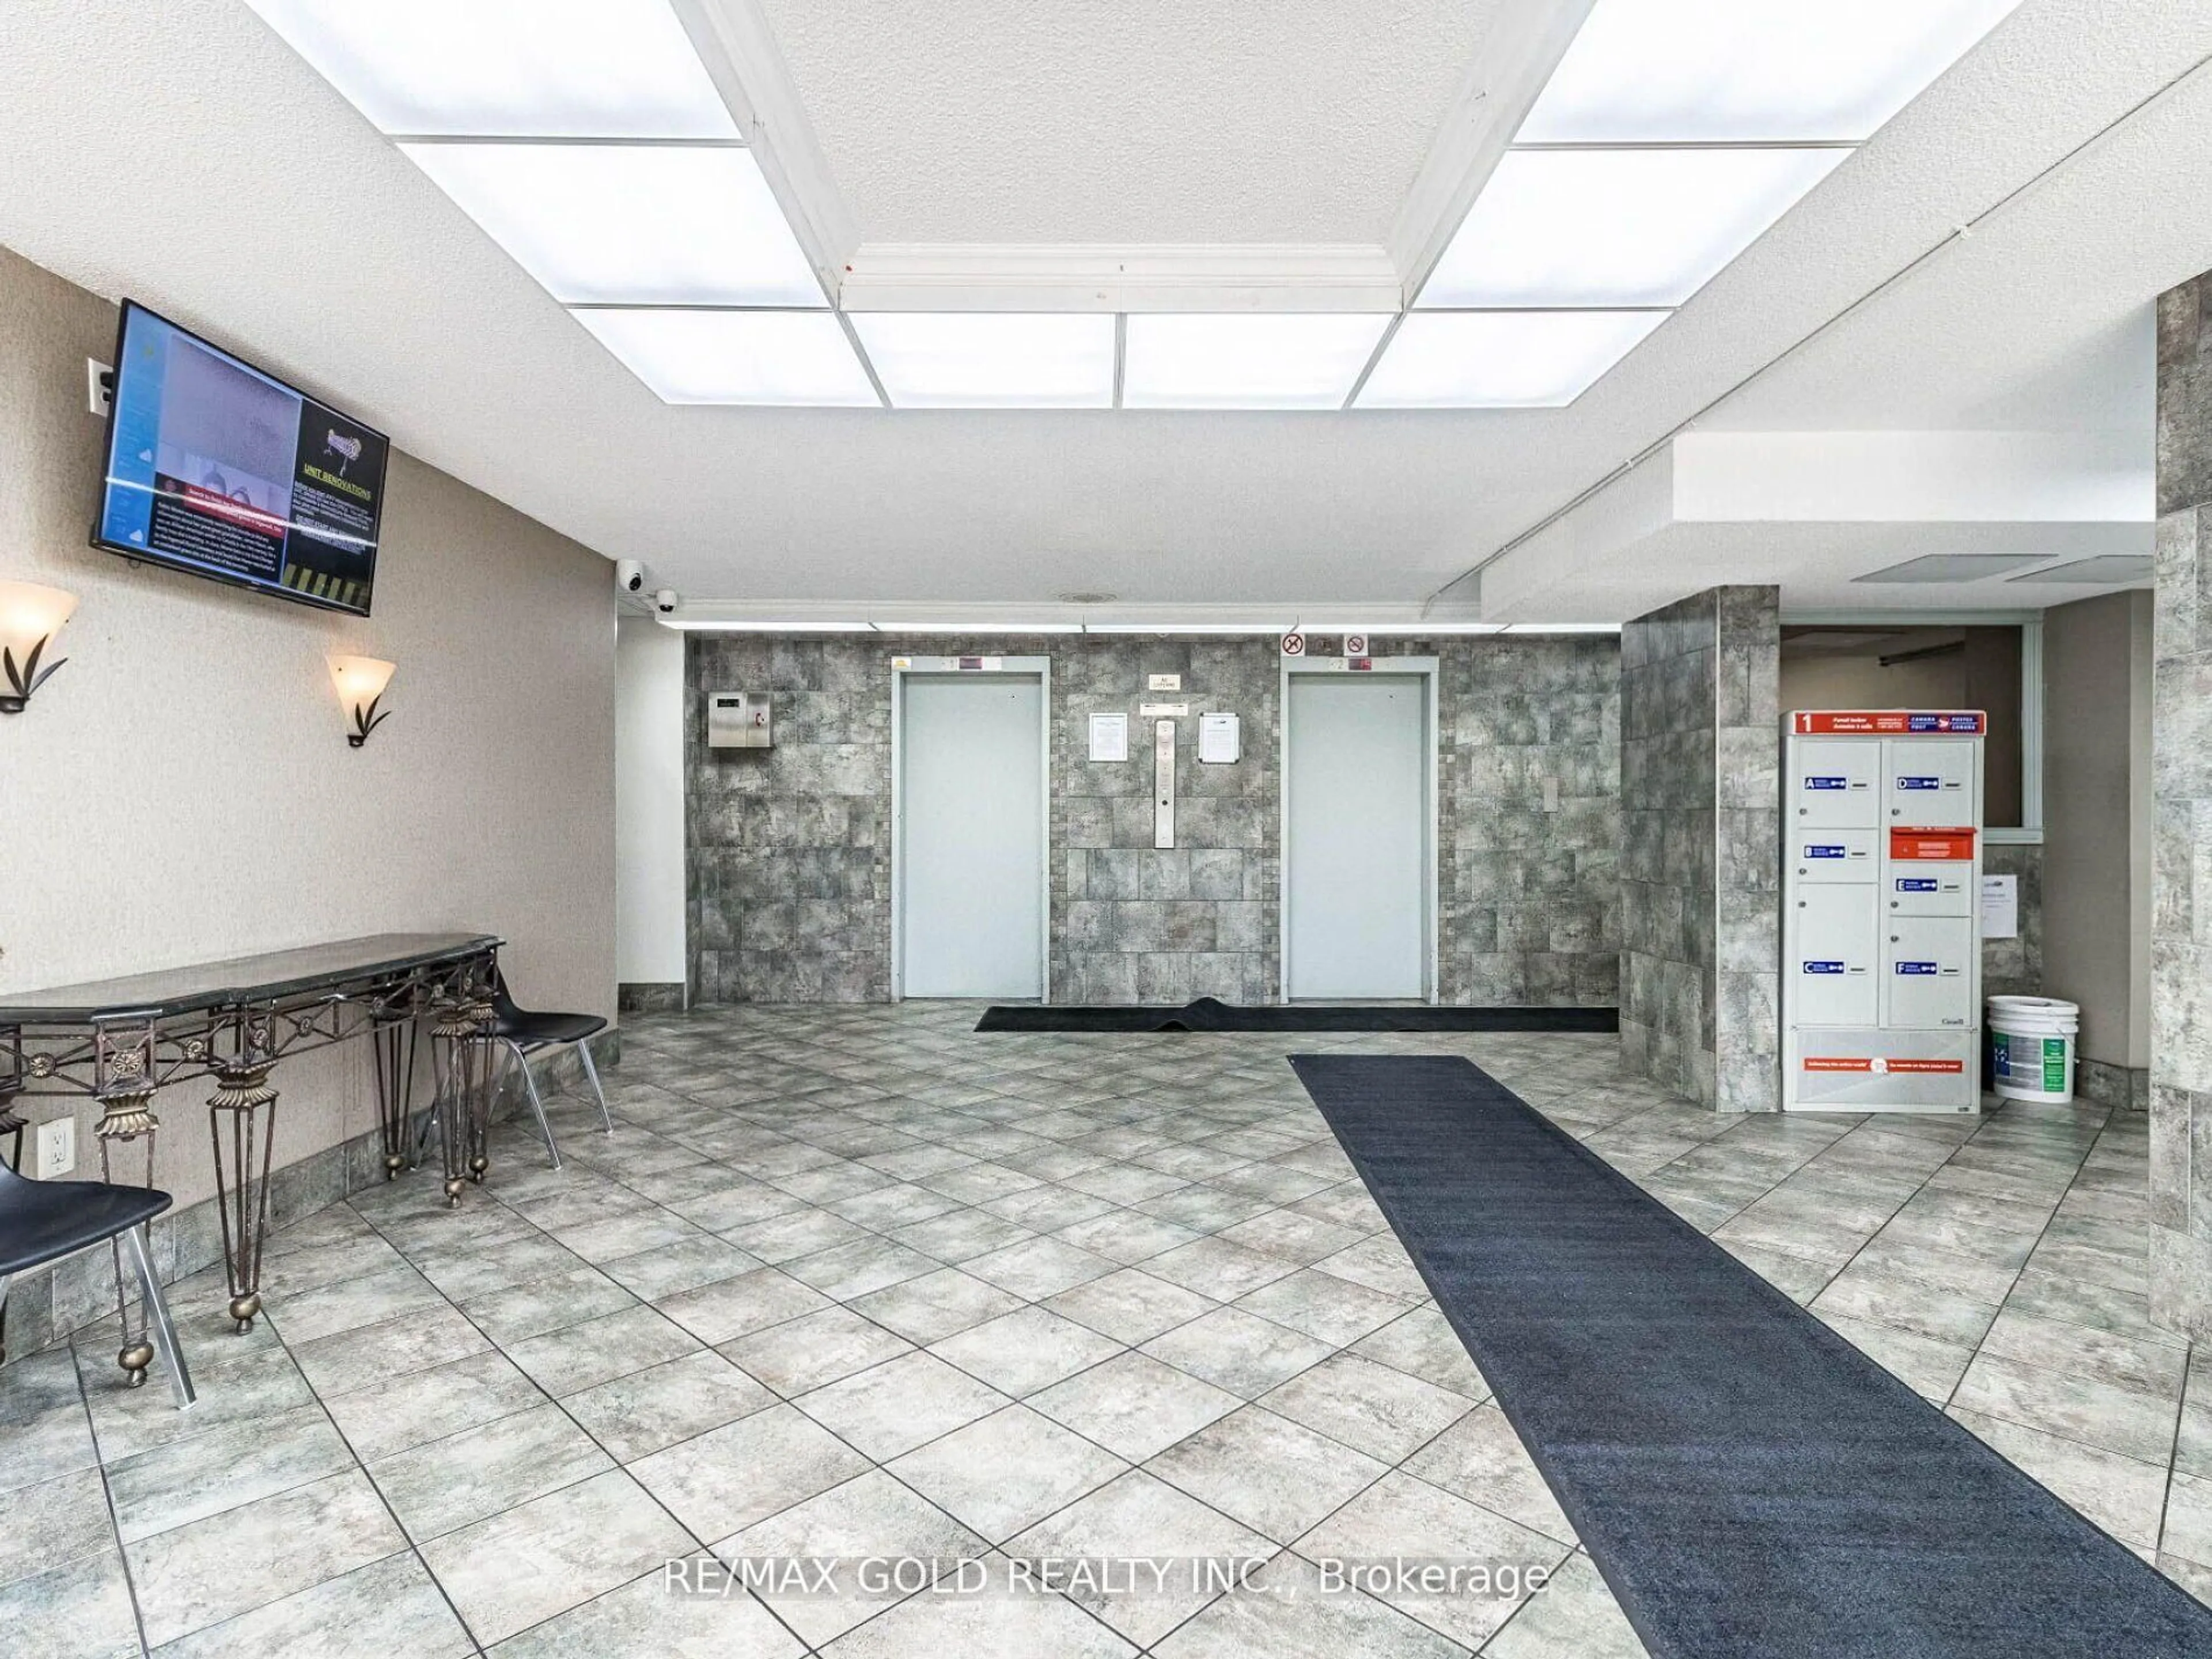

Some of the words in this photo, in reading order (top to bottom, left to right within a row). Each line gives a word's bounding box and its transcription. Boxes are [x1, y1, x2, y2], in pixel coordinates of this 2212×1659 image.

[304, 463, 323, 479] UNIT
[1802, 713, 1812, 732] 1
[1805, 778, 1815, 789] A
[1897, 778, 1907, 789] D
[1805, 847, 1813, 857] B
[1897, 880, 1905, 891] E
[1804, 963, 1814, 972] C
[1897, 963, 1905, 973] F
